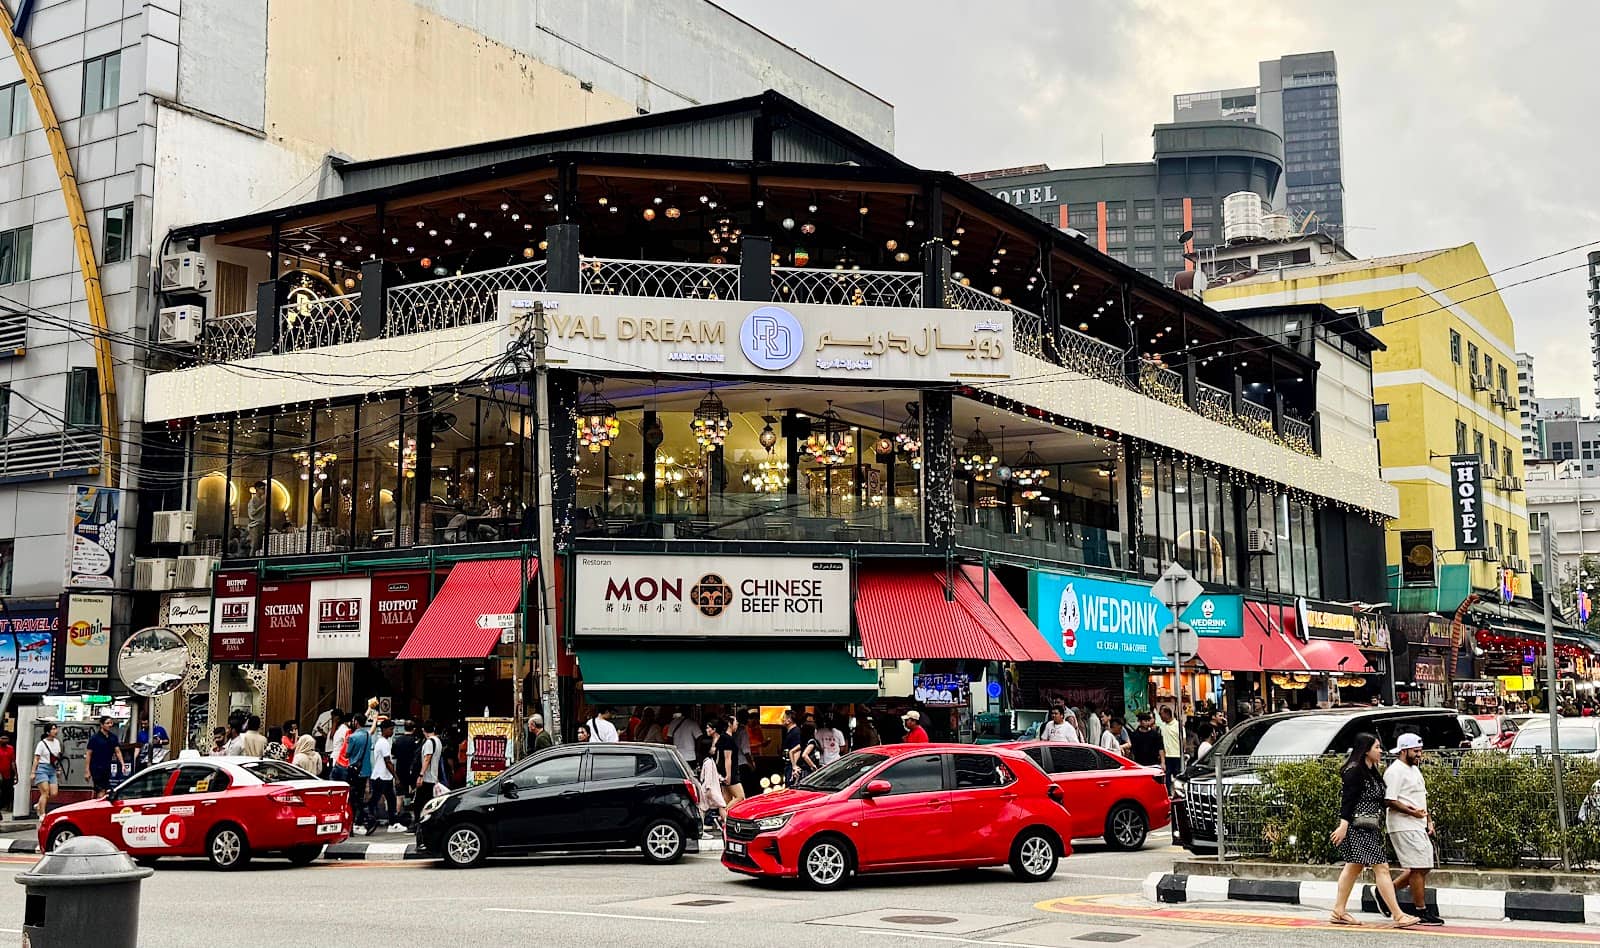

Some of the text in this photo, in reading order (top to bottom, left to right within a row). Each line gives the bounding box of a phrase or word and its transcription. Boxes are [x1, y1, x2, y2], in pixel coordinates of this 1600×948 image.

[991, 185, 1058, 206] OTEL
[616, 316, 727, 344] DREAM
[1456, 466, 1479, 545] HOTEL
[581, 558, 613, 567] Restoran
[604, 576, 683, 602] MON
[740, 579, 823, 597] CHINESE
[264, 603, 304, 616] SICHUAN
[378, 599, 419, 612] HOTPOT
[741, 597, 823, 614] BEEF ROTI
[270, 615, 297, 628] RASA
[381, 611, 414, 625] MALA
[1081, 594, 1159, 637] WEDRINK
[1189, 618, 1227, 627] WEDRINK
[12, 617, 50, 632] TRAVEL
[70, 618, 103, 639] Sunbit
[64, 666, 108, 675] BUKA 24 JAM
[127, 824, 156, 834] airasia
